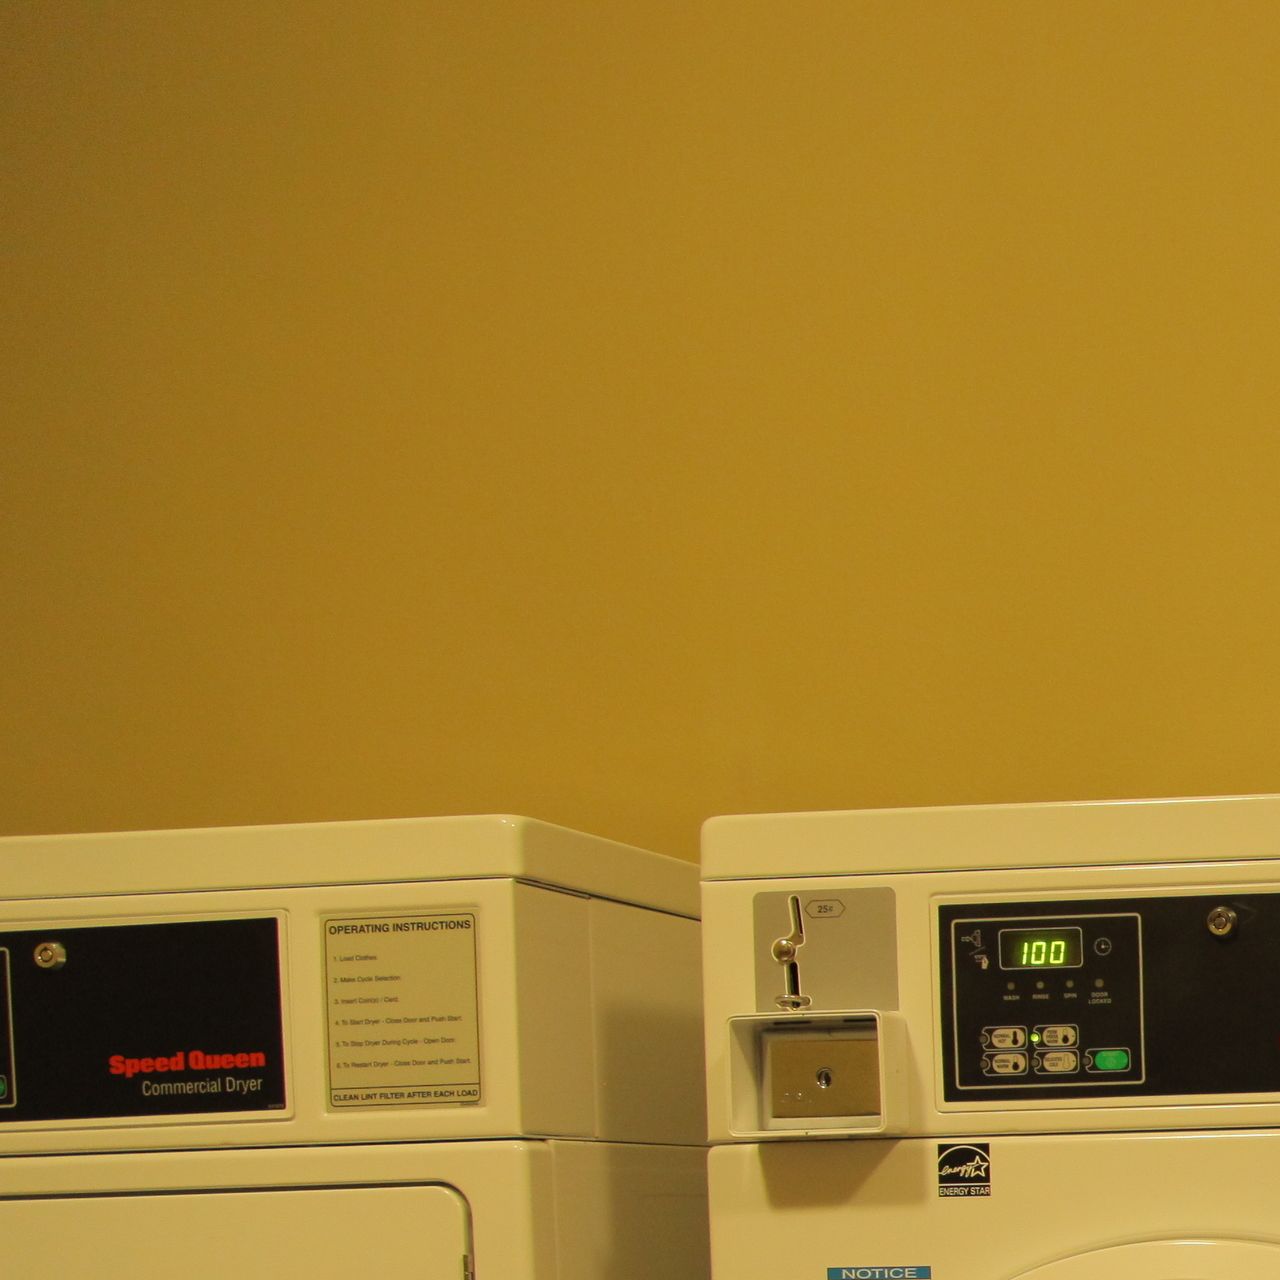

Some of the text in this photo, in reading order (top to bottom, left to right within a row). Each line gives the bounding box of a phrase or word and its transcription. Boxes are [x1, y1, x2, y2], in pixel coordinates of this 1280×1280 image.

[329, 920, 471, 934] OPERATING INSTRUCTIONS
[1022, 941, 1064, 965] 100
[109, 1051, 265, 1077] Speed Queen
[142, 1077, 262, 1096] Commercial Dryer
[939, 1187, 990, 1195] ENERGY STAR
[842, 1268, 917, 1279] NOTICE
